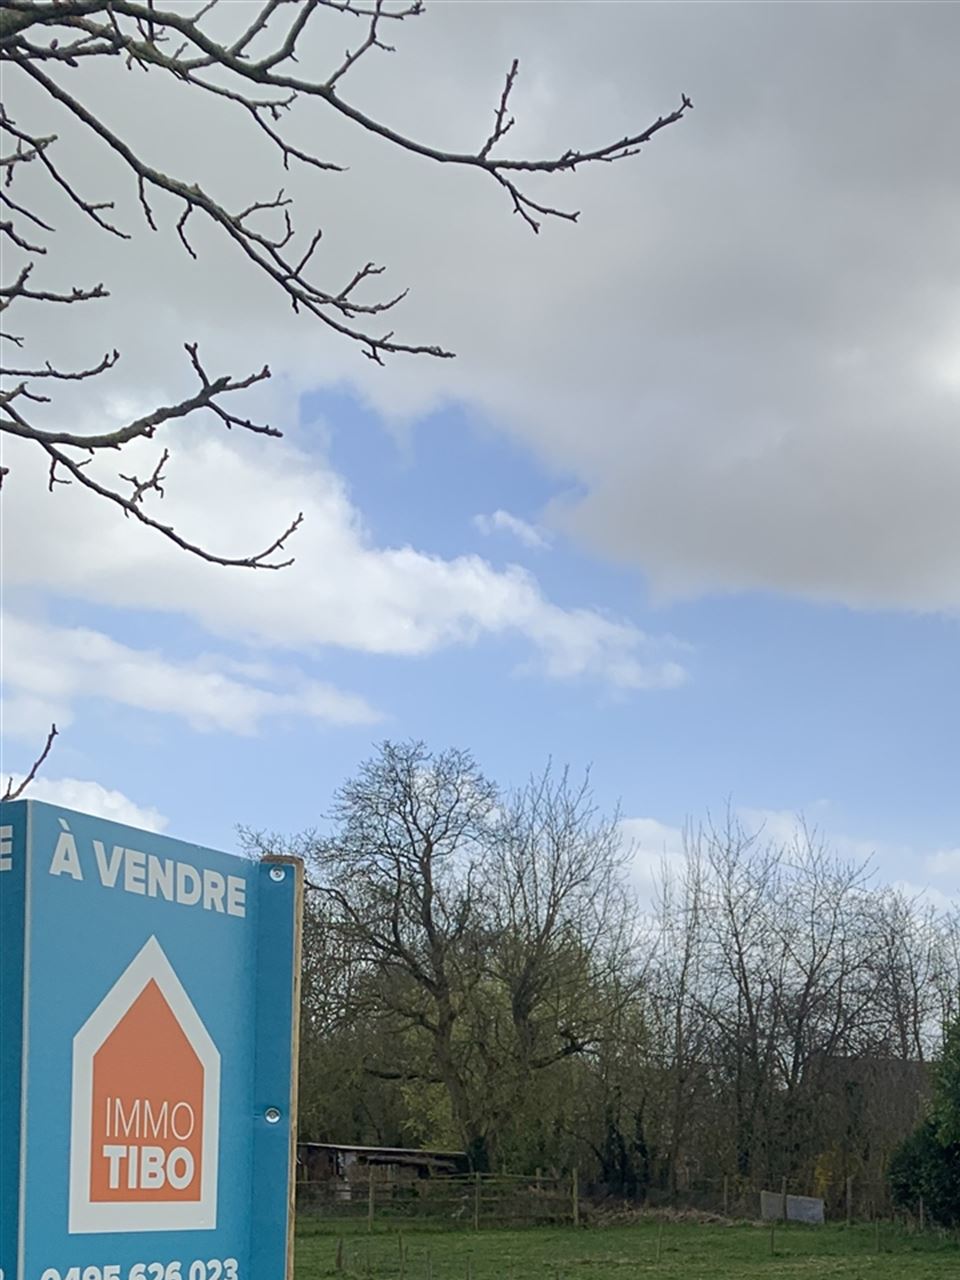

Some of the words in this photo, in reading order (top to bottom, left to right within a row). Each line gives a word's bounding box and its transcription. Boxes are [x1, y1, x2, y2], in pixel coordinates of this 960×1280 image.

[49, 817, 83, 881] À
[92, 840, 246, 918] VENDRE
[105, 1097, 194, 1141] IMMO
[103, 1145, 194, 1190] TIBO
